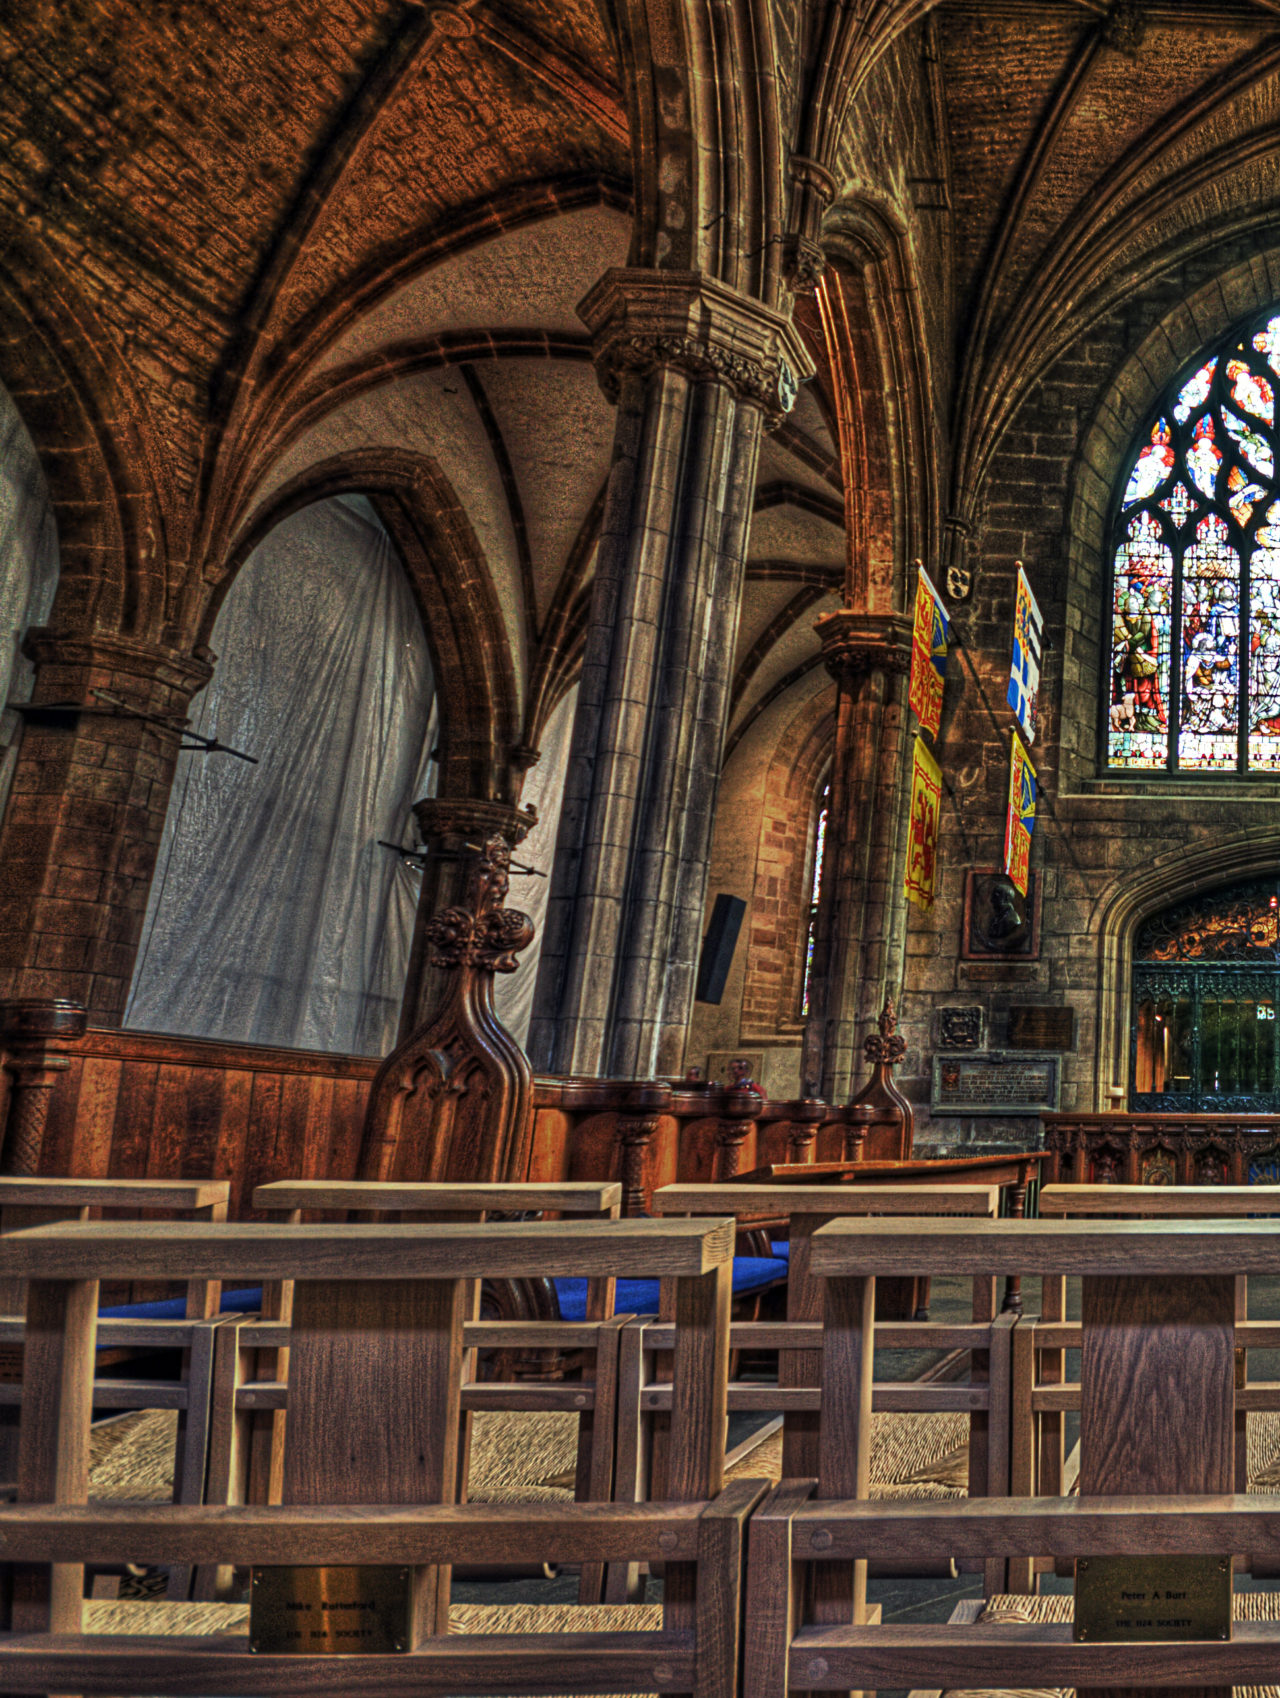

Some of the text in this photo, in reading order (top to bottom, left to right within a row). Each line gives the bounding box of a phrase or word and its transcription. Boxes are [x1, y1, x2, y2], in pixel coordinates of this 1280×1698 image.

[1121, 1591, 1146, 1600] Peter
[1152, 1591, 1160, 1600] A
[1115, 1619, 1131, 1628] THE
[1157, 1619, 1192, 1628] SOCIETY
